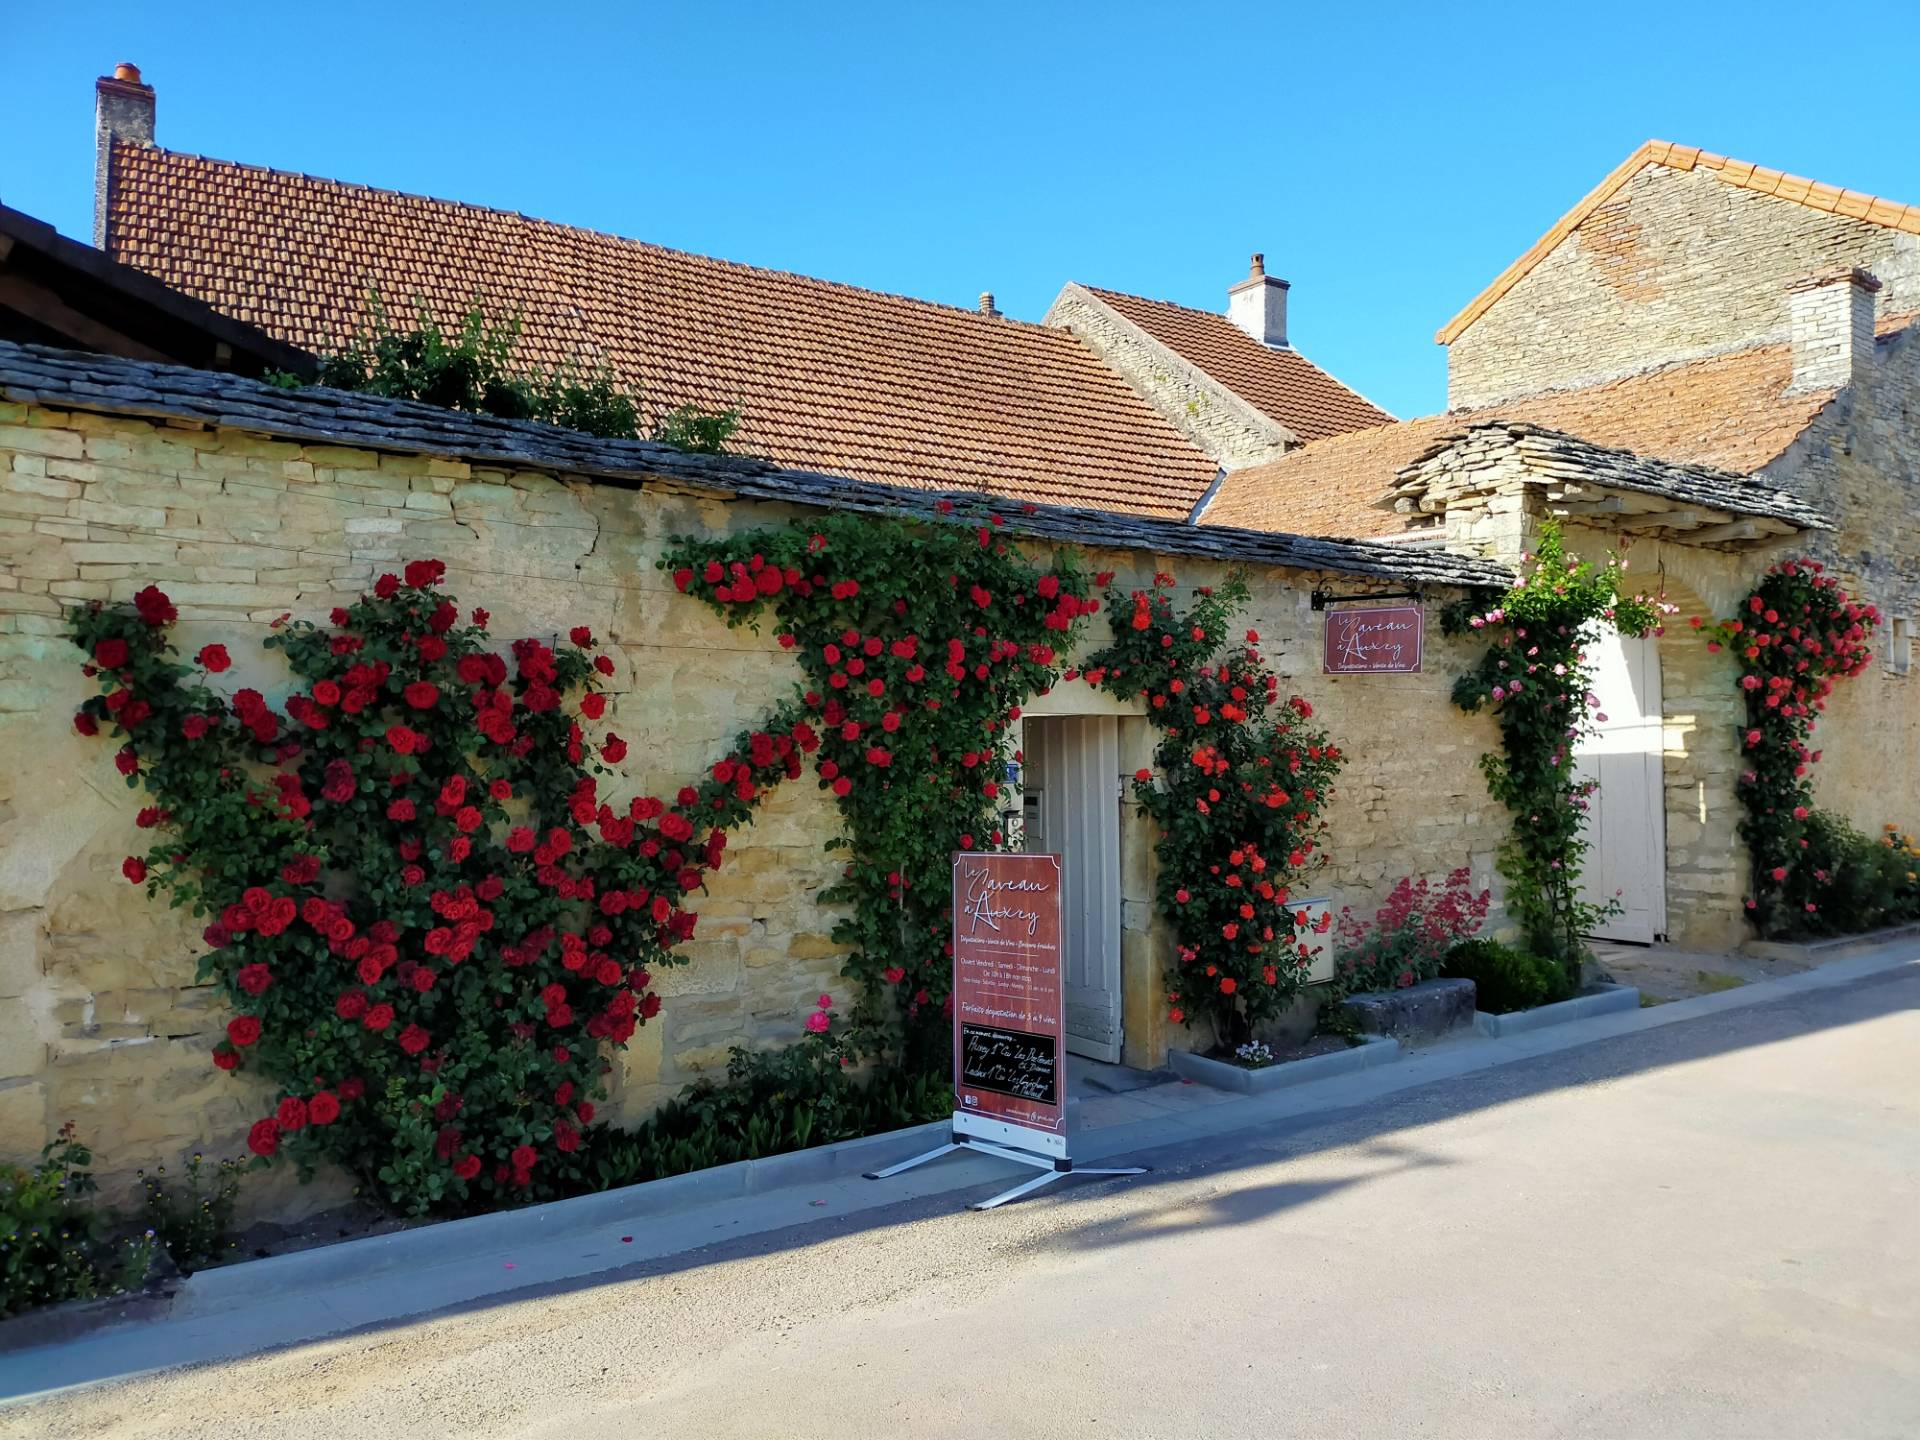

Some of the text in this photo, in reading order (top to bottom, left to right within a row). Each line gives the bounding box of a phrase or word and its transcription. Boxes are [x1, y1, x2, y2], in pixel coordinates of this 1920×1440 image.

[1341, 617, 1413, 641] Caveau
[1343, 632, 1404, 664] Auxey
[968, 868, 1049, 902] Caveau
[972, 891, 1040, 935] Auxey
